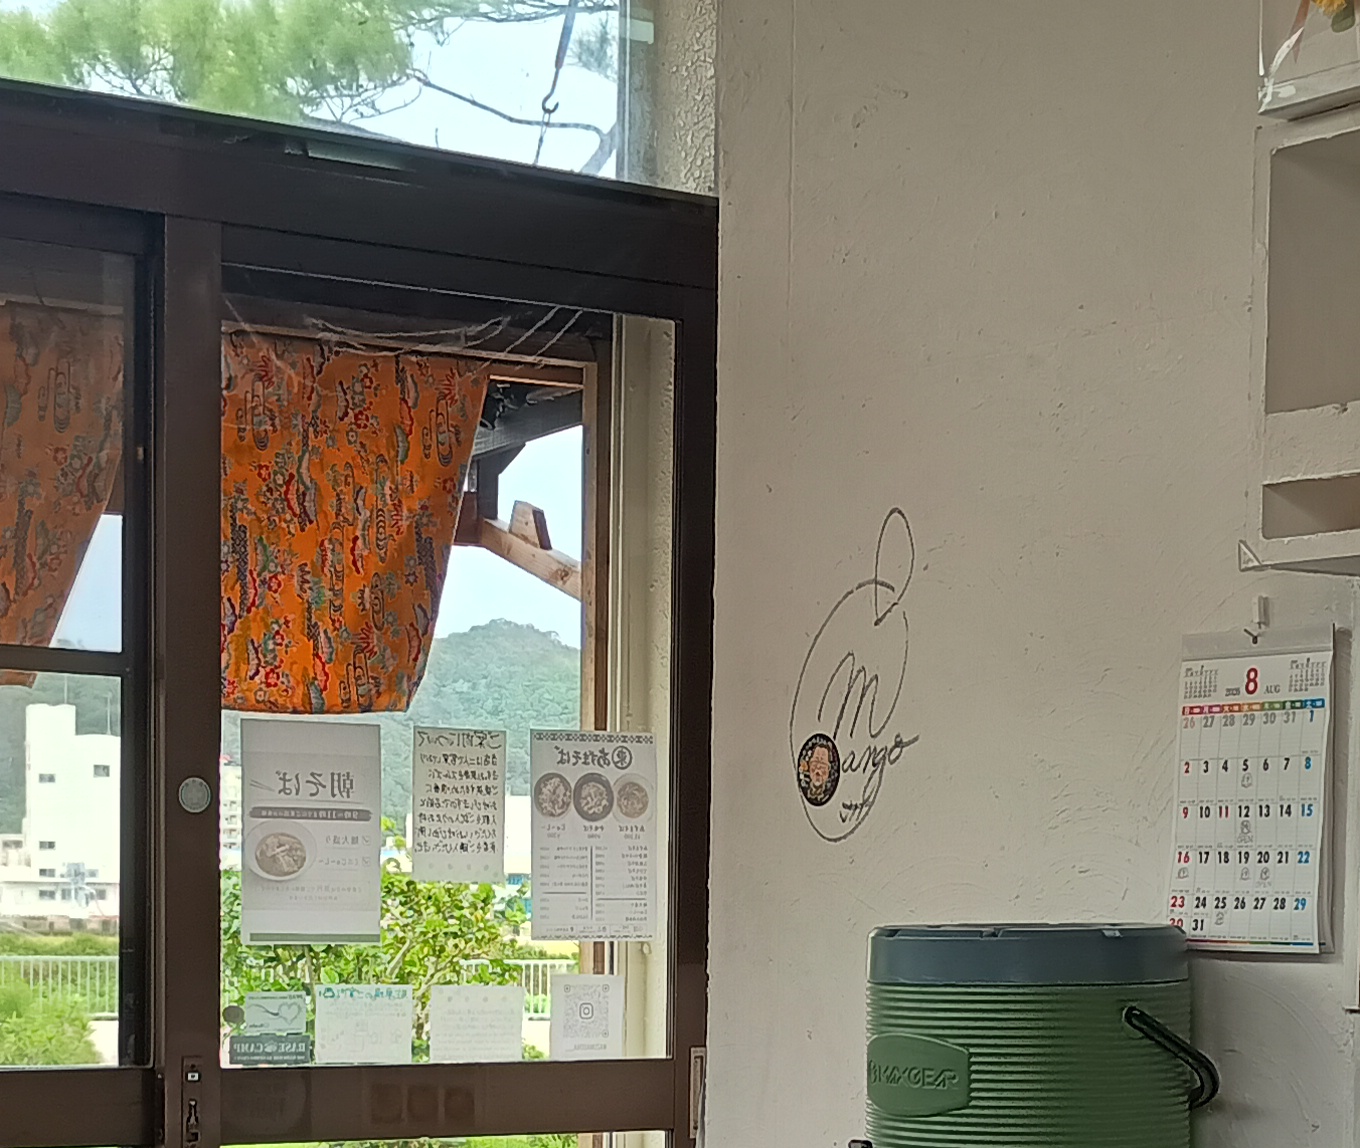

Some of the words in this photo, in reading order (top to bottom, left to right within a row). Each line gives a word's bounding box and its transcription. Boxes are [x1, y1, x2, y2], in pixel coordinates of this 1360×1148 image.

[1244, 667, 1259, 695] 8
[1264, 684, 1280, 695] AUG
[1183, 717, 1195, 729] 26
[1203, 715, 1215, 728] 27
[1222, 714, 1235, 727] 28
[1242, 713, 1256, 726] 29
[1263, 712, 1276, 725] 30
[1283, 711, 1296, 724] 31
[1309, 710, 1315, 723] 1
[1184, 760, 1190, 774] 2
[1203, 760, 1209, 773] 3
[1222, 759, 1228, 772] 4
[1242, 758, 1249, 772] 5
[1262, 757, 1269, 772] 6
[1283, 757, 1291, 771] 7
[1304, 756, 1312, 770] 8
[1182, 806, 1189, 819] 9
[1199, 805, 1211, 819] 10
[1218, 804, 1229, 818] 11
[1238, 804, 1251, 818] 12
[1258, 804, 1271, 818] 13
[1279, 804, 1292, 818] 14
[1301, 803, 1313, 817] 15
[1177, 851, 1190, 864] 16
[1198, 851, 1210, 864] 17
[1217, 851, 1230, 864] 18
[1238, 851, 1250, 864] 19
[1256, 851, 1270, 864] 20
[1277, 851, 1289, 864] 21
[1297, 851, 1311, 864] 22
[1170, 895, 1186, 908] 23
[1194, 896, 1207, 909] 24
[1214, 896, 1227, 910] 25
[1233, 896, 1247, 910] 26
[1253, 896, 1267, 910] 27
[1273, 897, 1287, 910] 28
[1294, 897, 1307, 911] 29
[1192, 918, 1204, 932] 31
